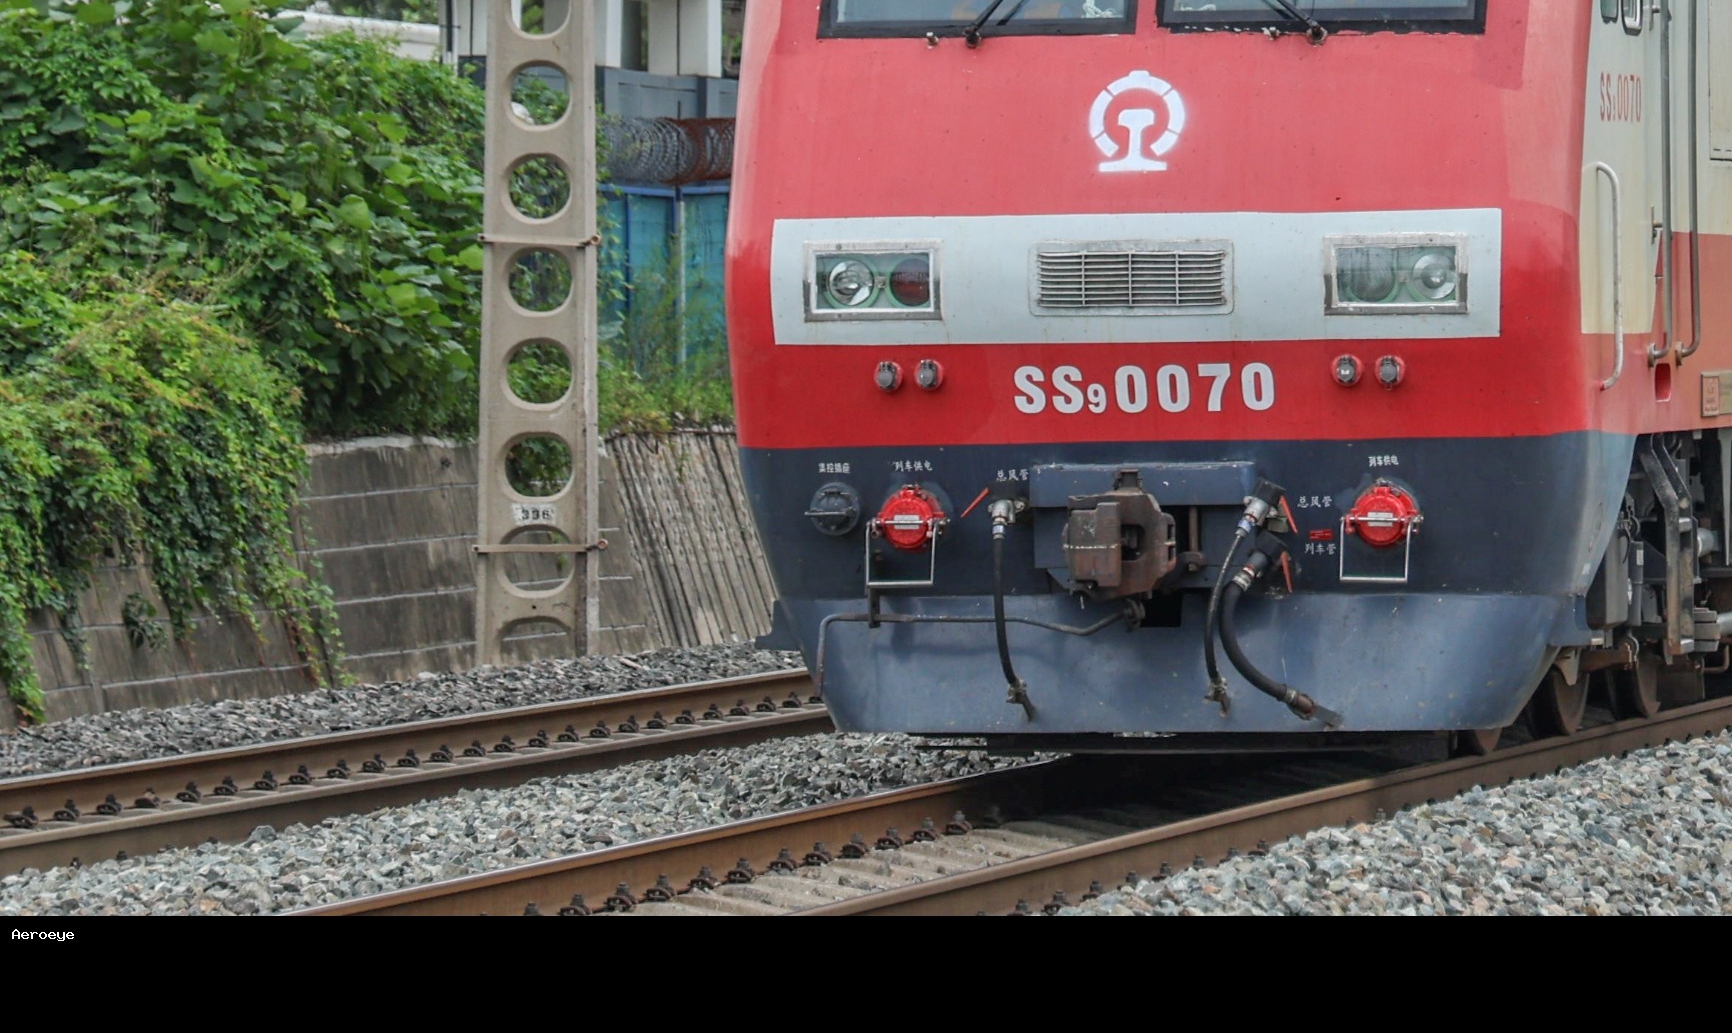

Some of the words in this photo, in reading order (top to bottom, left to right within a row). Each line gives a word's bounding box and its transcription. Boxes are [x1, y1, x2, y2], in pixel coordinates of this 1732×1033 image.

[894, 460, 934, 473] 列车供电
[1367, 454, 1400, 468] 列车供电
[995, 468, 1030, 482] 总风管
[1297, 495, 1333, 509] 总风管
[1304, 542, 1337, 556] 列车管
